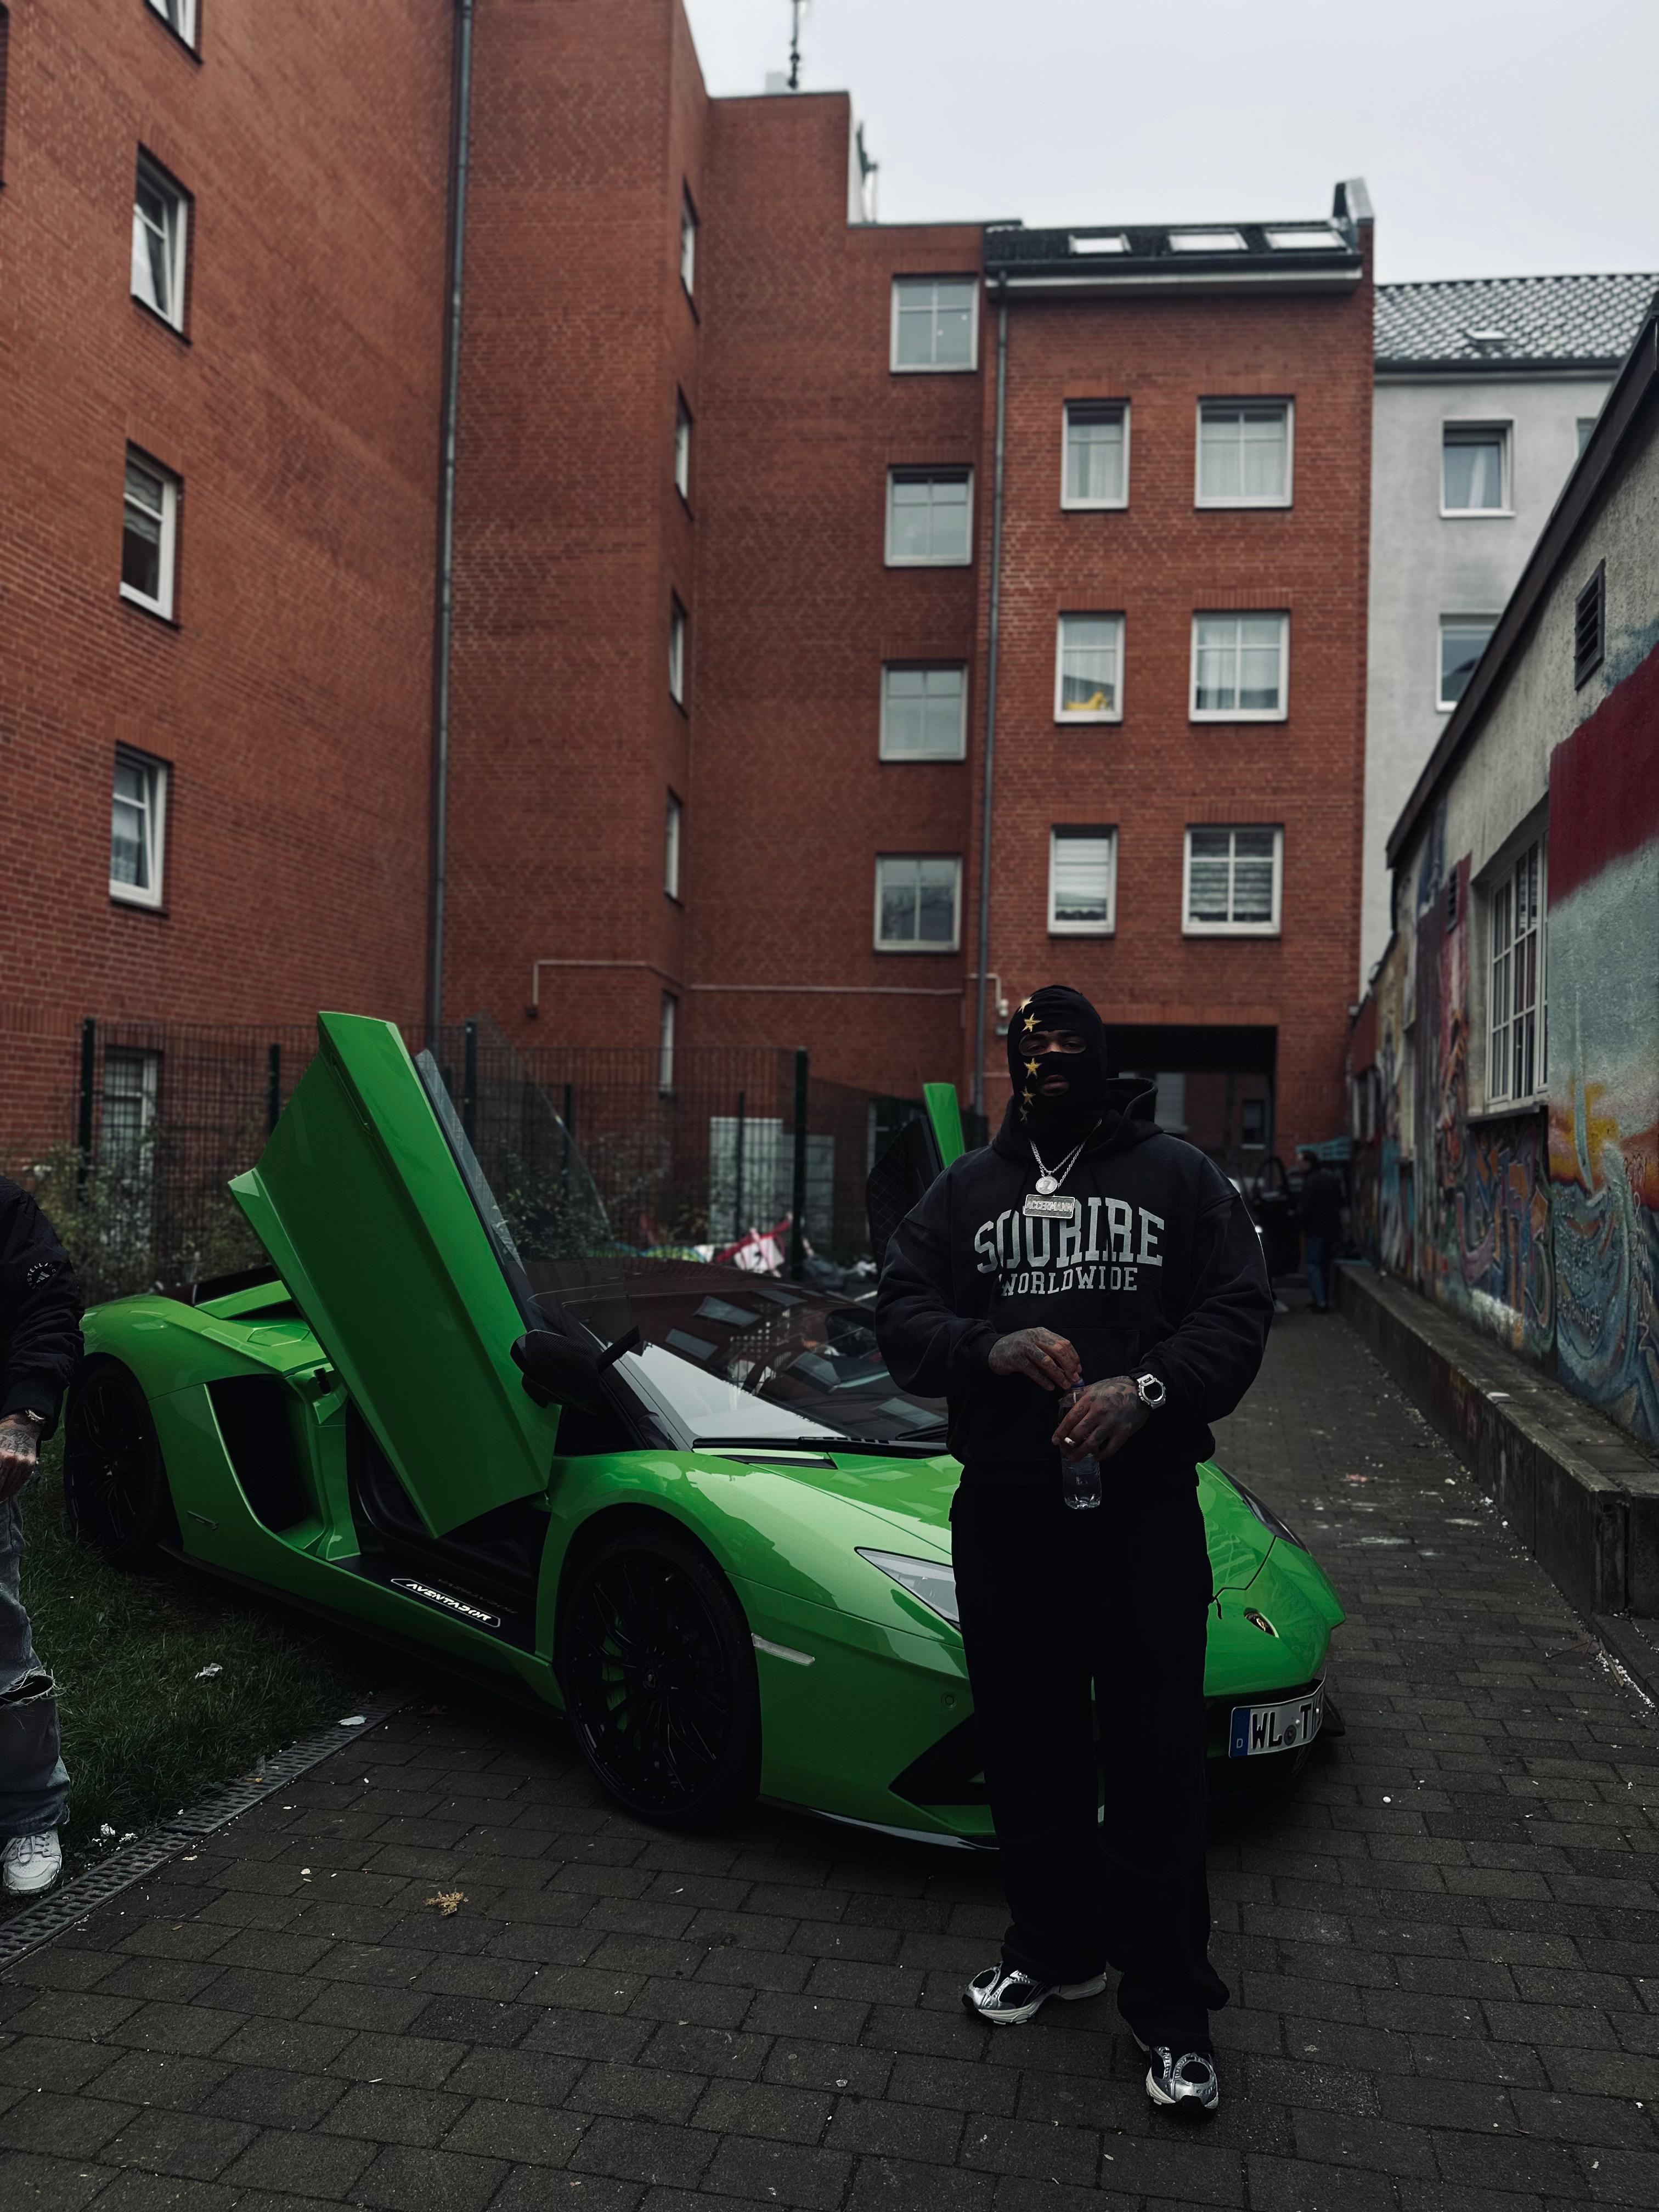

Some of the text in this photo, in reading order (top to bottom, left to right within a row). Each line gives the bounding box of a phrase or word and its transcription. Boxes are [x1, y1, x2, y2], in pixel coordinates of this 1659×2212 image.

[974, 1197, 1164, 1273] SOURIRE
[998, 1266, 1138, 1296] WORLDWIDE
[406, 1584, 492, 1621] AVENTADOR
[1236, 1738, 1243, 1748] D
